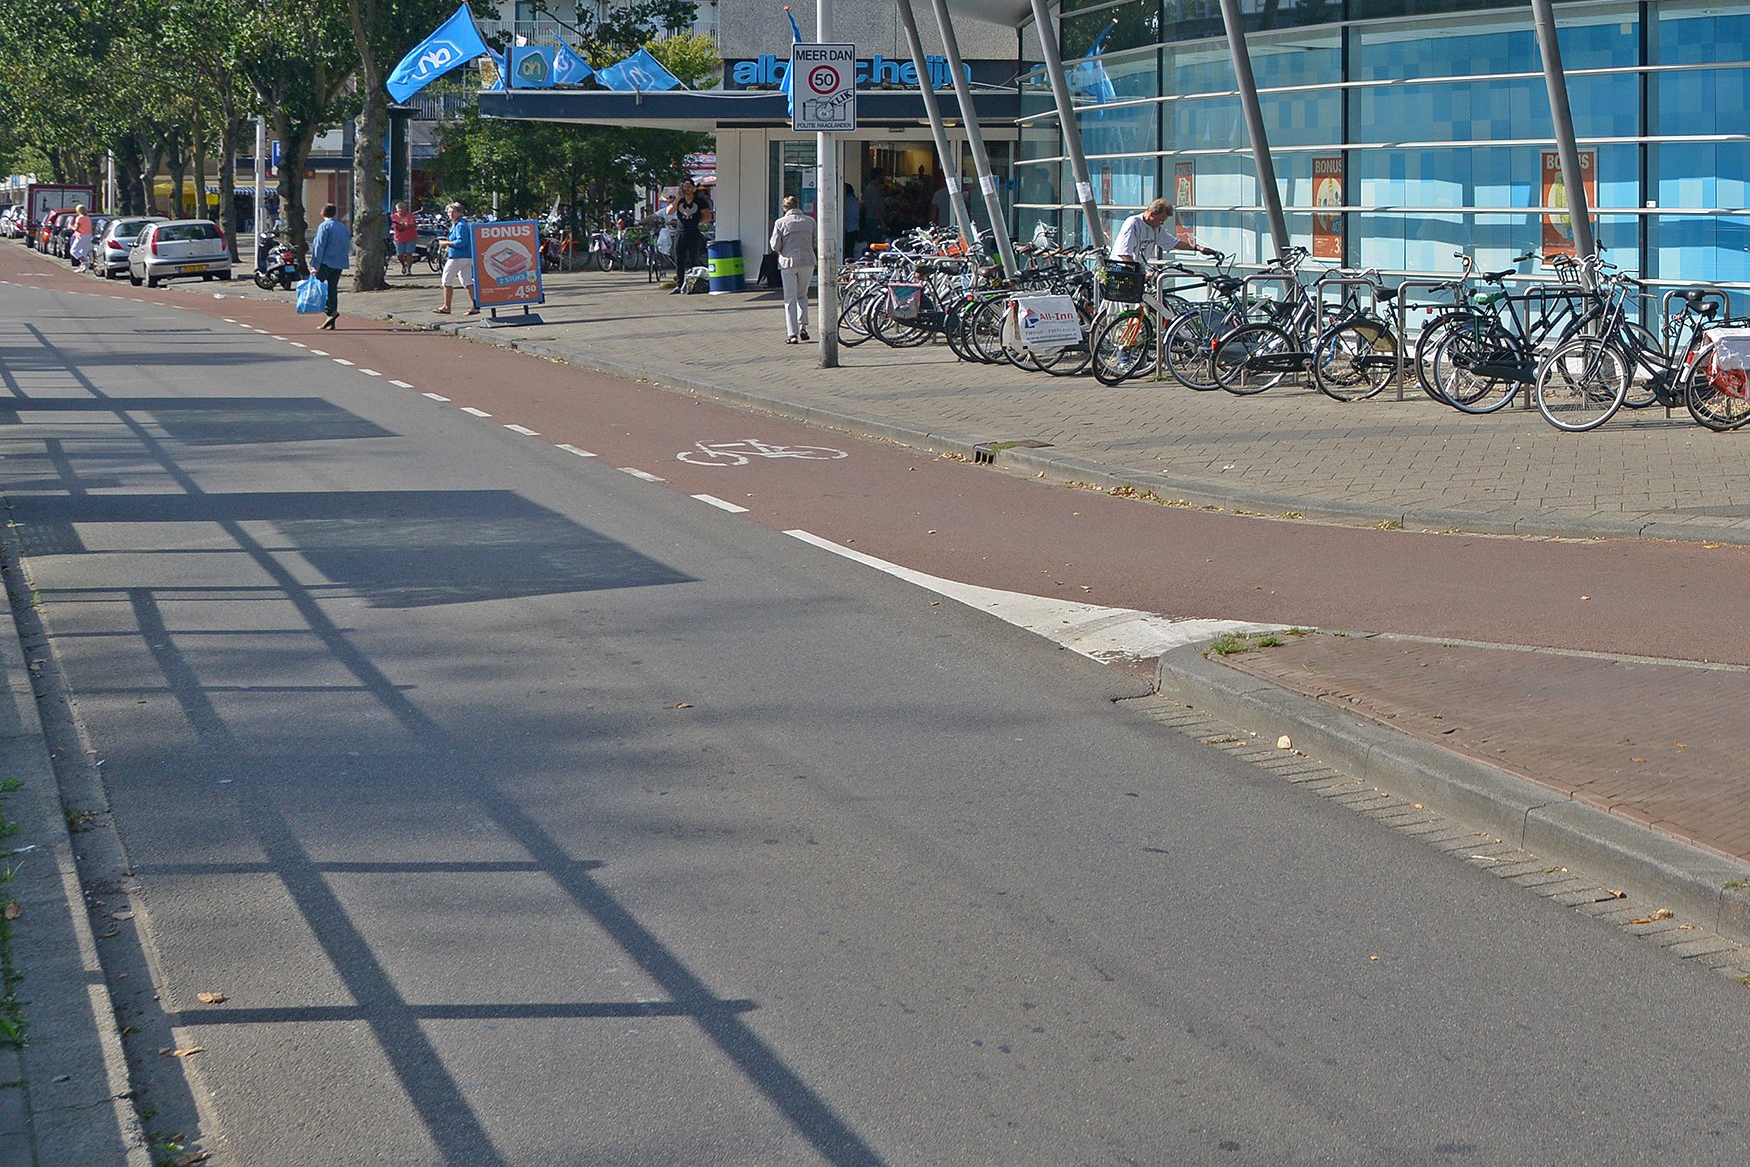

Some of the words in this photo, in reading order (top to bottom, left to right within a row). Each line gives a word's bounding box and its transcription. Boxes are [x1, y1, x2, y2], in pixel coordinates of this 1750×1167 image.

[796, 49, 828, 61] MEER
[829, 49, 852, 61] DAN
[814, 73, 834, 87] 50
[829, 90, 852, 108] KLIK
[480, 225, 531, 239] BONUS
[1040, 312, 1074, 321] All-Inn
